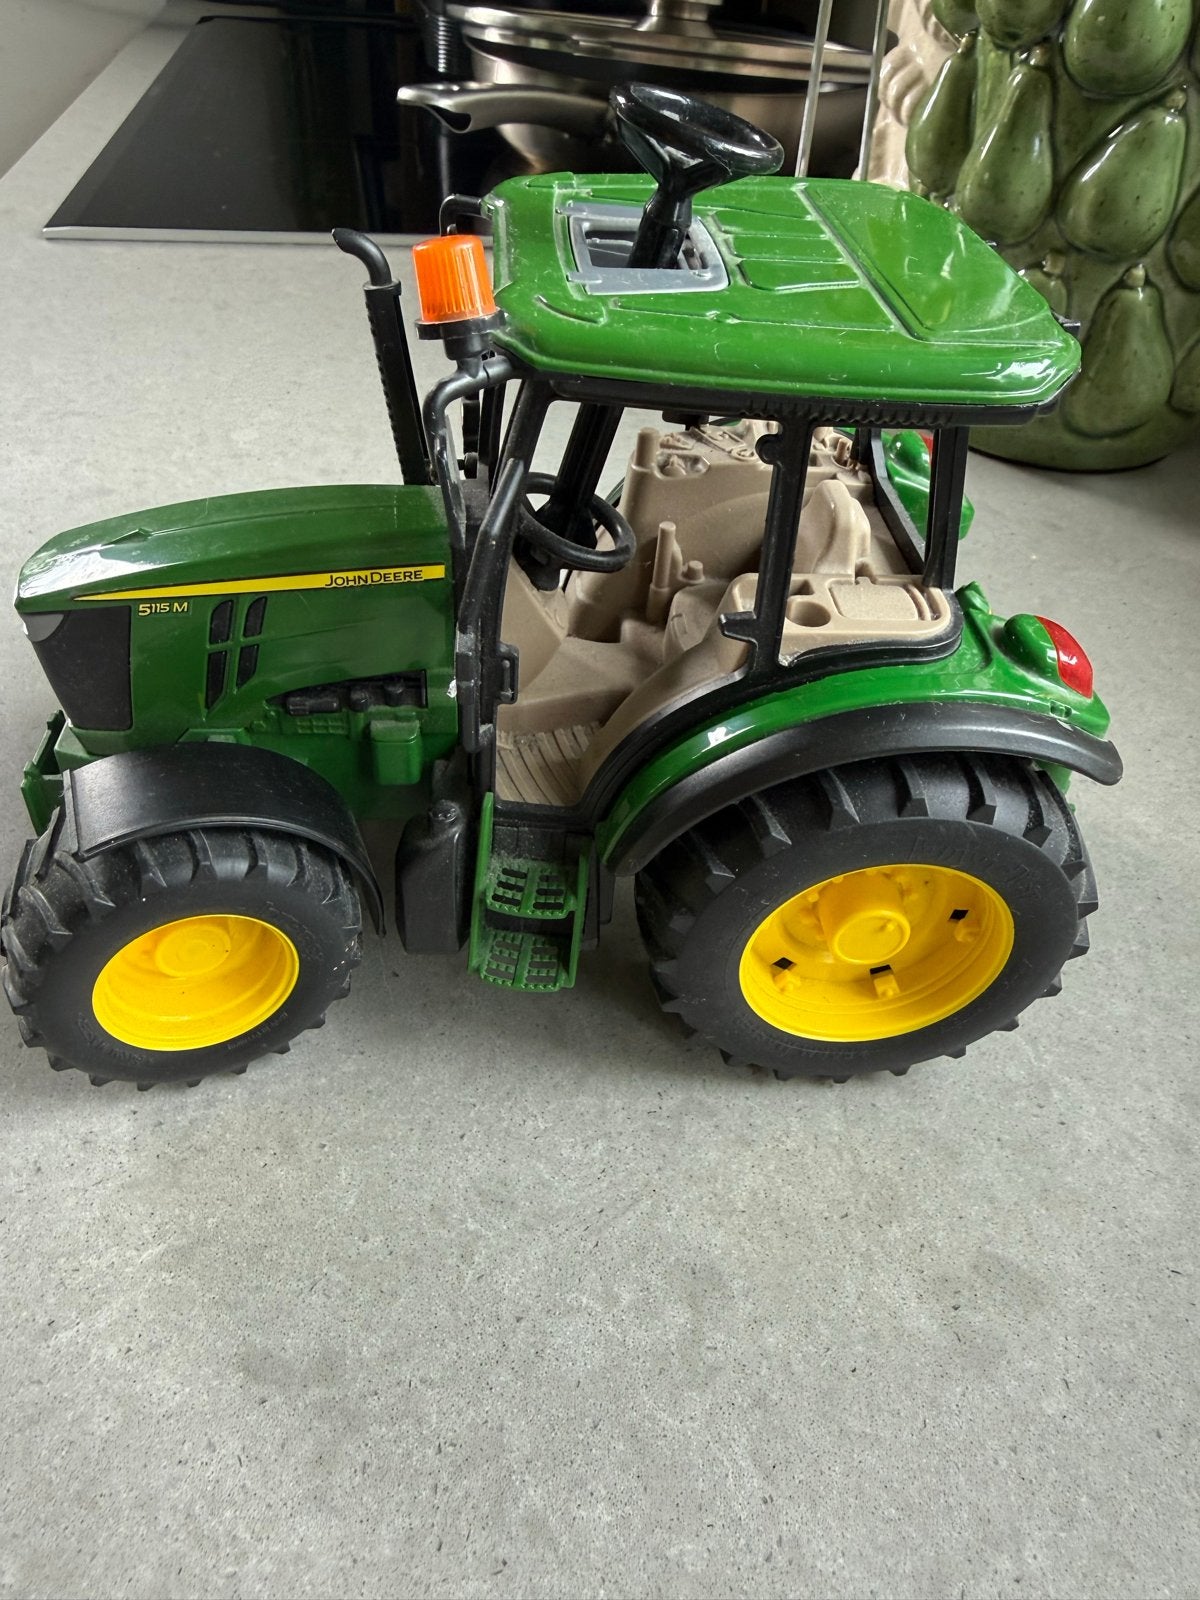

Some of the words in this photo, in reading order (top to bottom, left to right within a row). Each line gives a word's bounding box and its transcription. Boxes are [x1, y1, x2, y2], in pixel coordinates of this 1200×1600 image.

[325, 574, 368, 587] JOHN
[370, 569, 423, 584] DEERE
[138, 602, 170, 616] 5115
[172, 601, 189, 613] M
